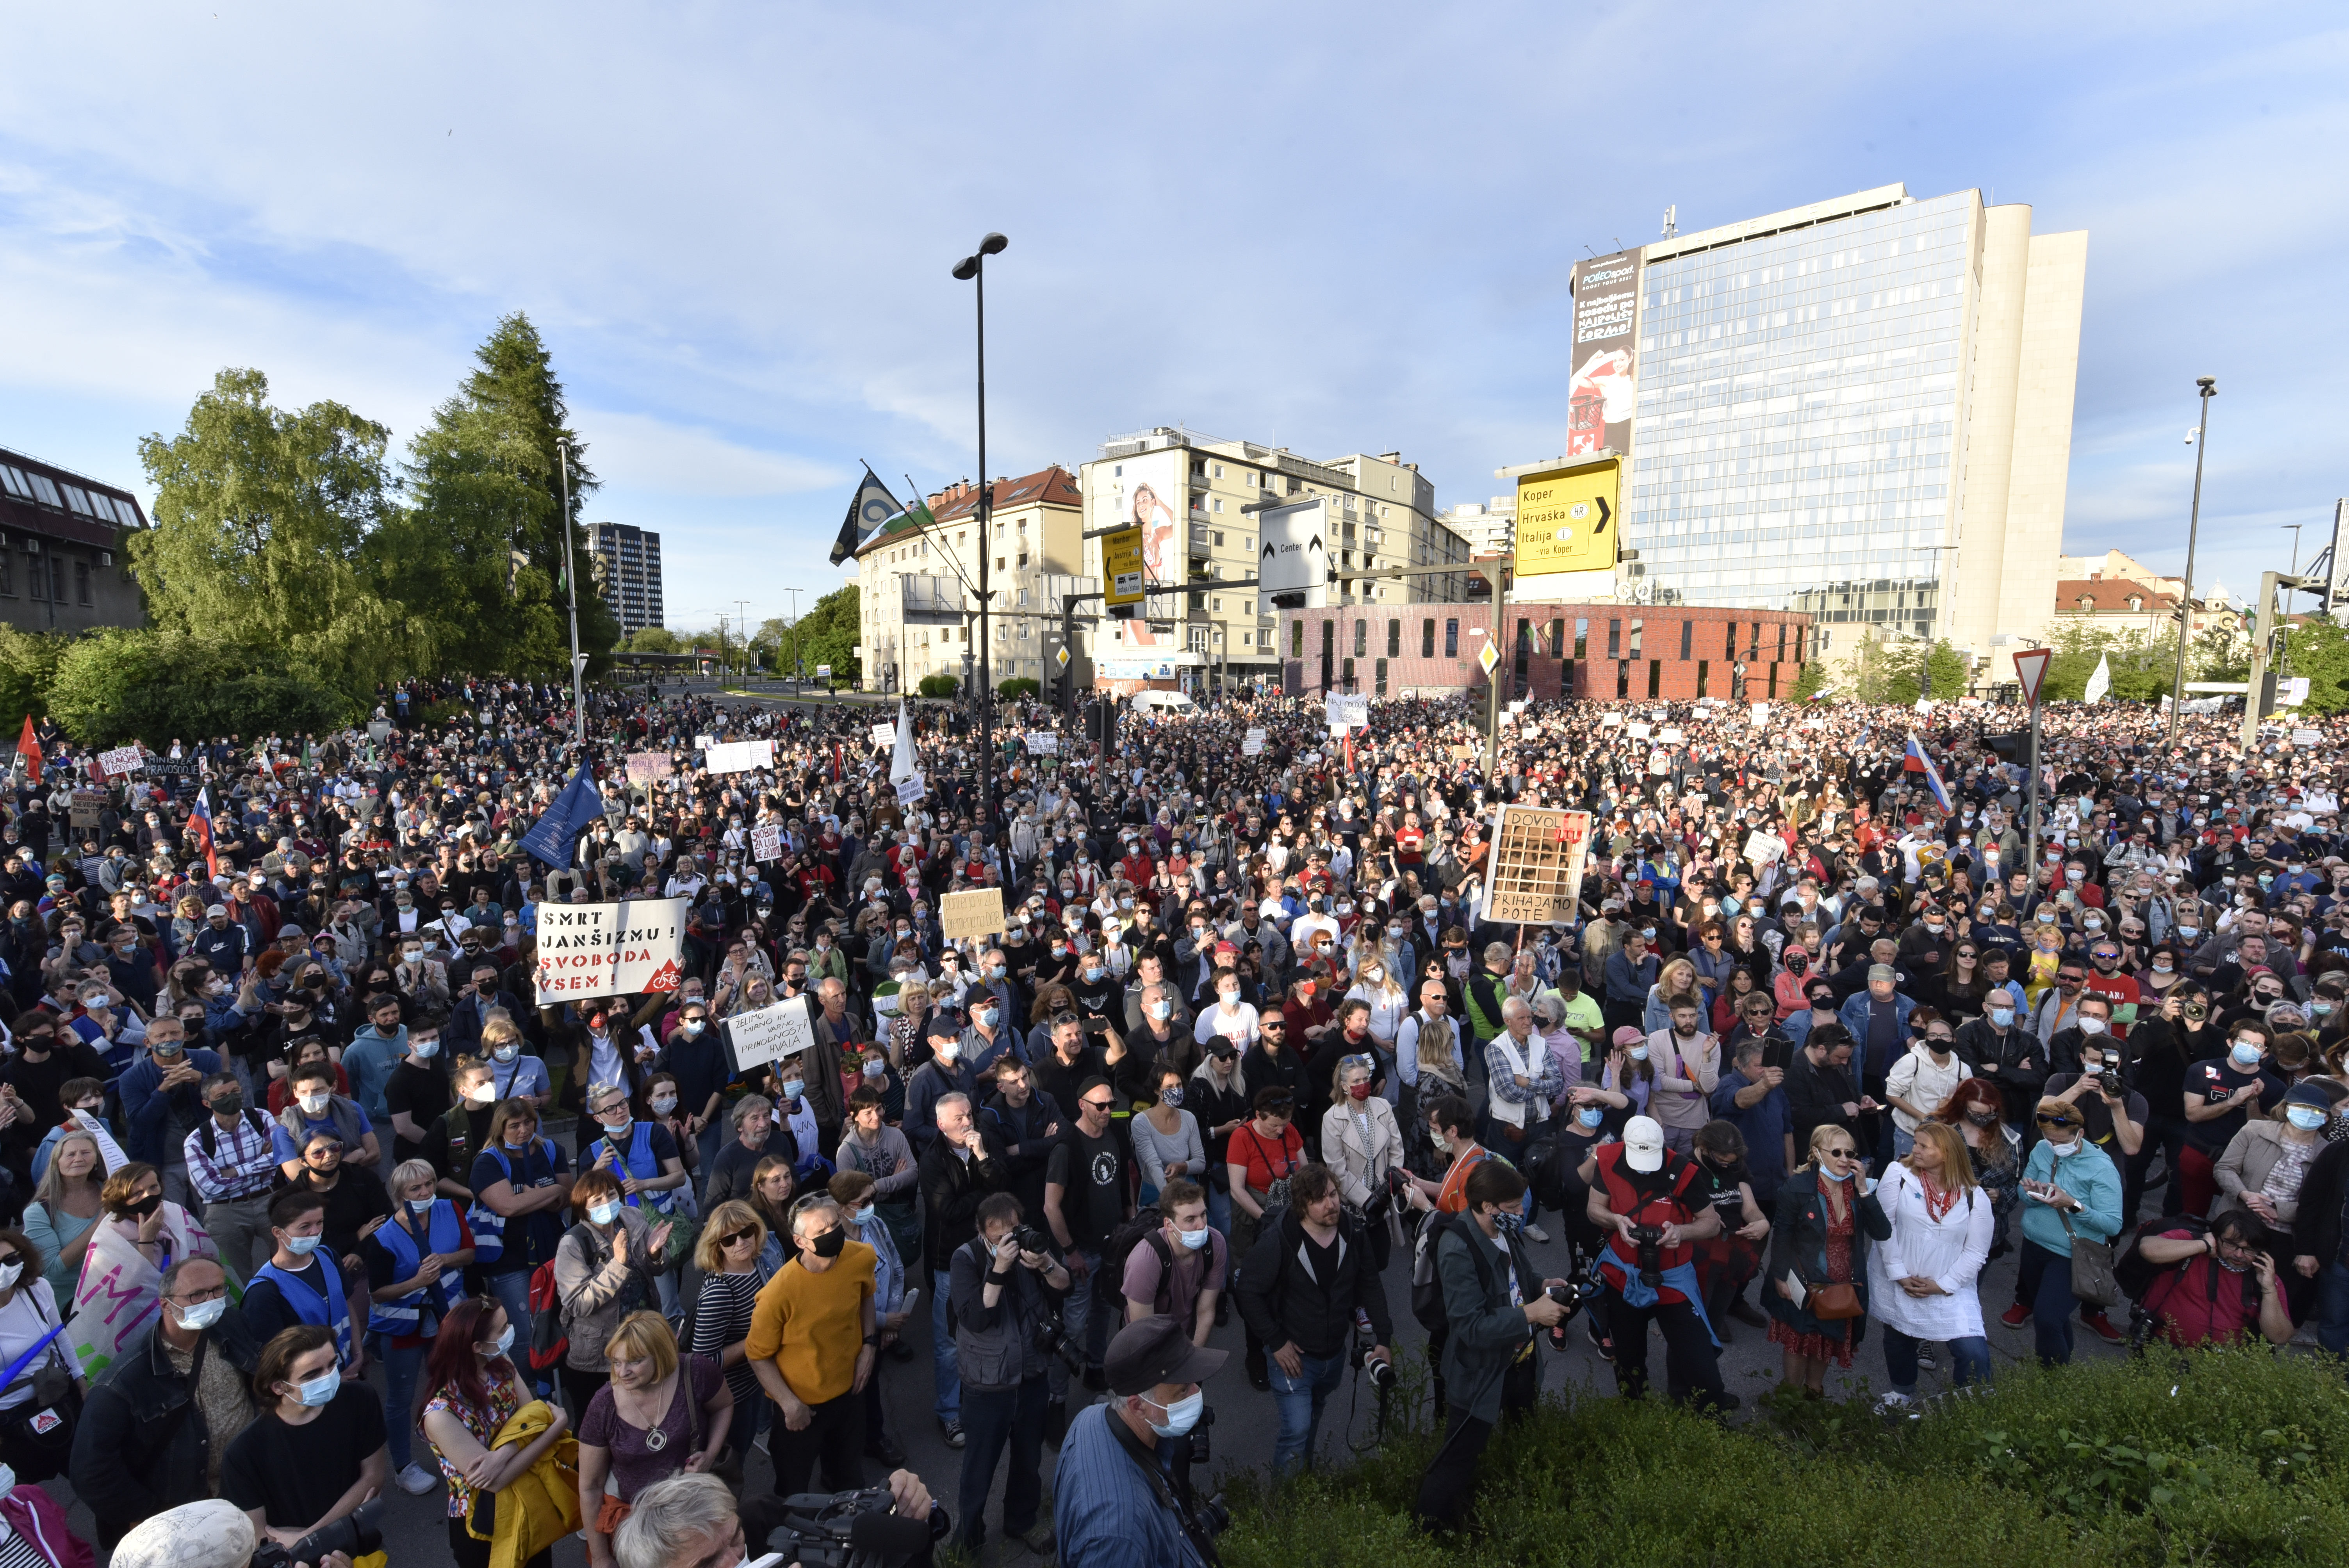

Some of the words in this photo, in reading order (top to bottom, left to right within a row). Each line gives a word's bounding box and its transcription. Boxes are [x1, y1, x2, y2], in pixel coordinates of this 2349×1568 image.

[1695, 219, 1773, 247] HOTEL
[1791, 200, 1840, 224] LEV
[1587, 292, 1634, 306] najboljšemu
[1579, 303, 1617, 318] sosedu
[1620, 300, 1634, 310] po
[1524, 490, 1553, 502] Koper
[1523, 510, 1565, 524] Hrvaška
[1574, 507, 1583, 517] HR
[1113, 535, 1130, 544] Maribor
[1522, 531, 1551, 543] Italija
[1281, 542, 1302, 552] Center
[1553, 545, 1573, 556] Koper
[1114, 550, 1131, 559] Avstrija
[1328, 697, 1341, 706] NAJ
[2185, 702, 2219, 712] STAVKA
[99, 747, 135, 760] DELAVSKO
[102, 752, 141, 767] UPRAVLJANJE
[112, 761, 144, 773] PODJETJA
[149, 757, 193, 765] MINISTER
[145, 765, 198, 775] PRAVOSODJE
[752, 826, 776, 841] SVOBODA
[755, 840, 763, 850] ZA
[756, 852, 763, 860] NE
[764, 850, 771, 859] ZA
[945, 894, 975, 910] panterja
[984, 891, 1000, 906] ZOO
[1493, 894, 1570, 910] PRIHAJAMO
[544, 912, 602, 925] SMRT
[976, 916, 984, 927] na
[986, 911, 1001, 927] DOB
[542, 928, 659, 949] JANŠIZMU
[670, 927, 674, 939] !
[541, 949, 651, 970] SVOBODA
[539, 975, 599, 993] VSEM
[610, 973, 615, 985] !
[735, 1012, 764, 1029] ŽELIMO
[744, 1019, 773, 1035] MIRNO
[767, 1020, 795, 1033] VARNO
[741, 1018, 808, 1053] PRIHODNOST!
[770, 1035, 801, 1055] HVALA
[38, 1420, 61, 1433] UPOR!
